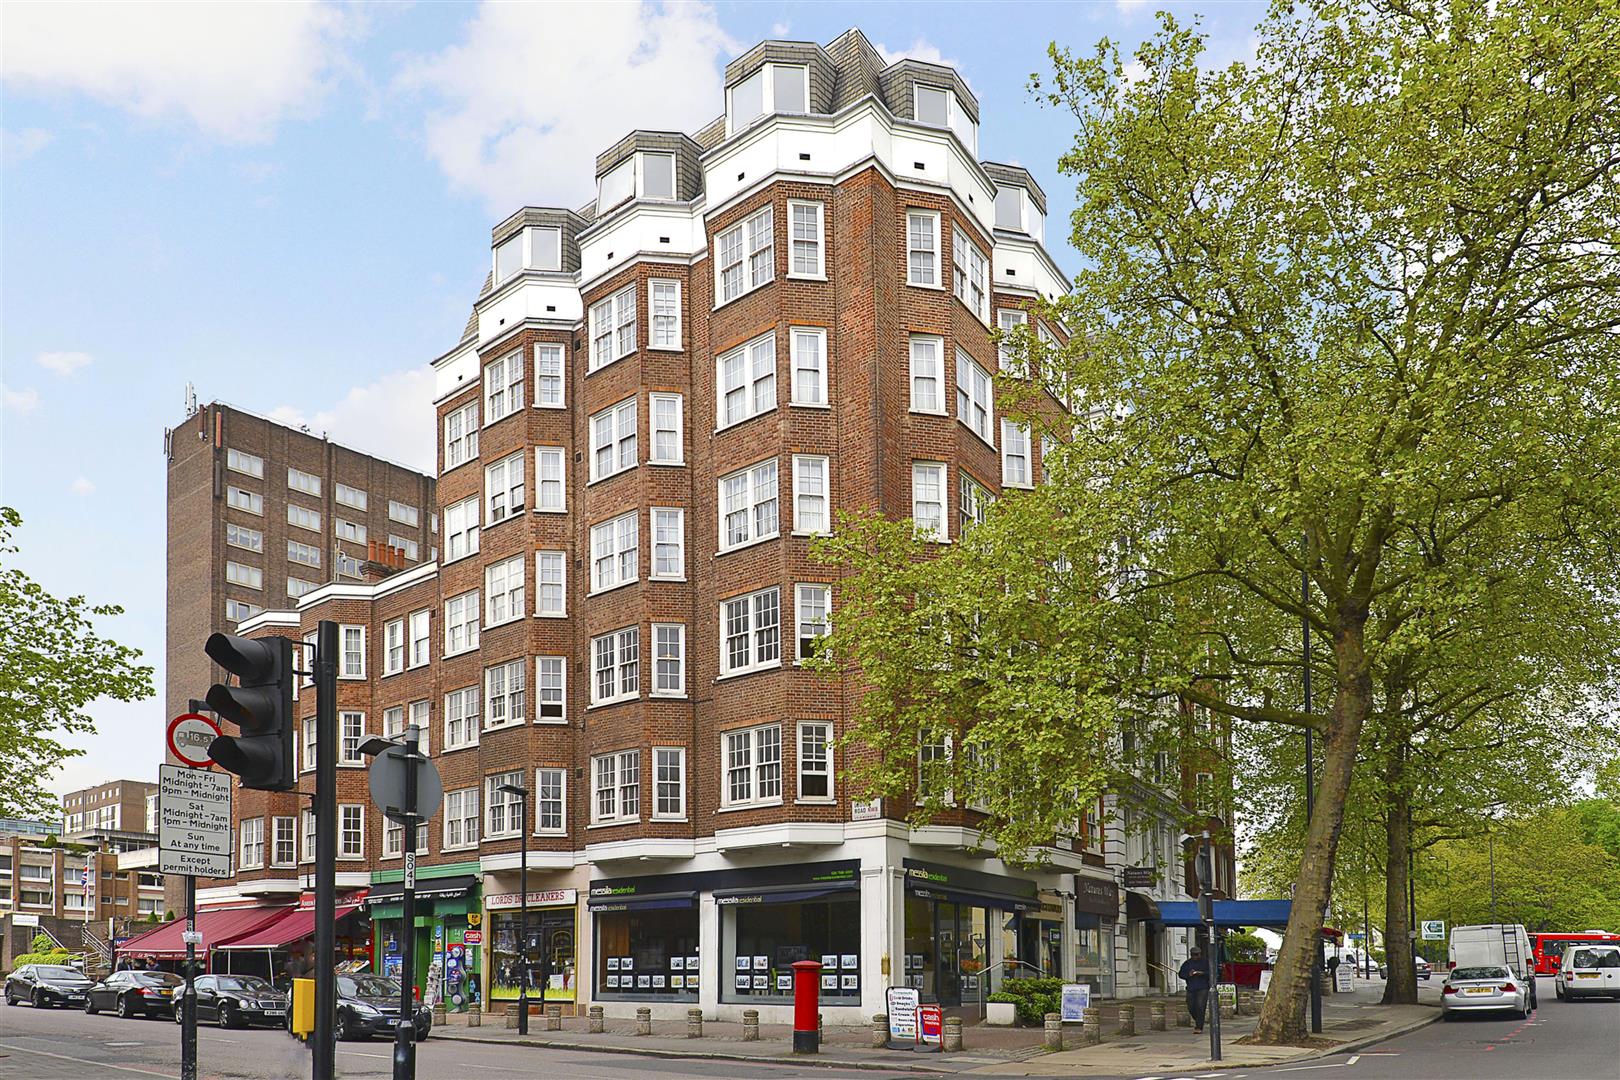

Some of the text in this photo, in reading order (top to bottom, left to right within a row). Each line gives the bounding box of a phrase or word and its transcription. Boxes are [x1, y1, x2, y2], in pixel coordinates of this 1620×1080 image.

[177, 770, 197, 780] Mon
[204, 774, 216, 782] Fri
[163, 776, 202, 789] Midnight
[211, 783, 228, 792] 7am
[162, 785, 182, 795] 9pm
[191, 790, 229, 801] Midnight
[189, 802, 204, 810] Sat
[163, 808, 203, 819] Midnight
[210, 813, 228, 822] 7am
[162, 817, 181, 825] 1pm
[190, 820, 228, 831] Midnight
[187, 832, 205, 841] Sun
[183, 842, 199, 850] any
[201, 843, 220, 851] time
[180, 855, 210, 865] Except
[163, 864, 226, 875] permit holders
[491, 895, 513, 905] LORDS
[526, 891, 565, 903] CLEANERS
[923, 1013, 940, 1021] cash
